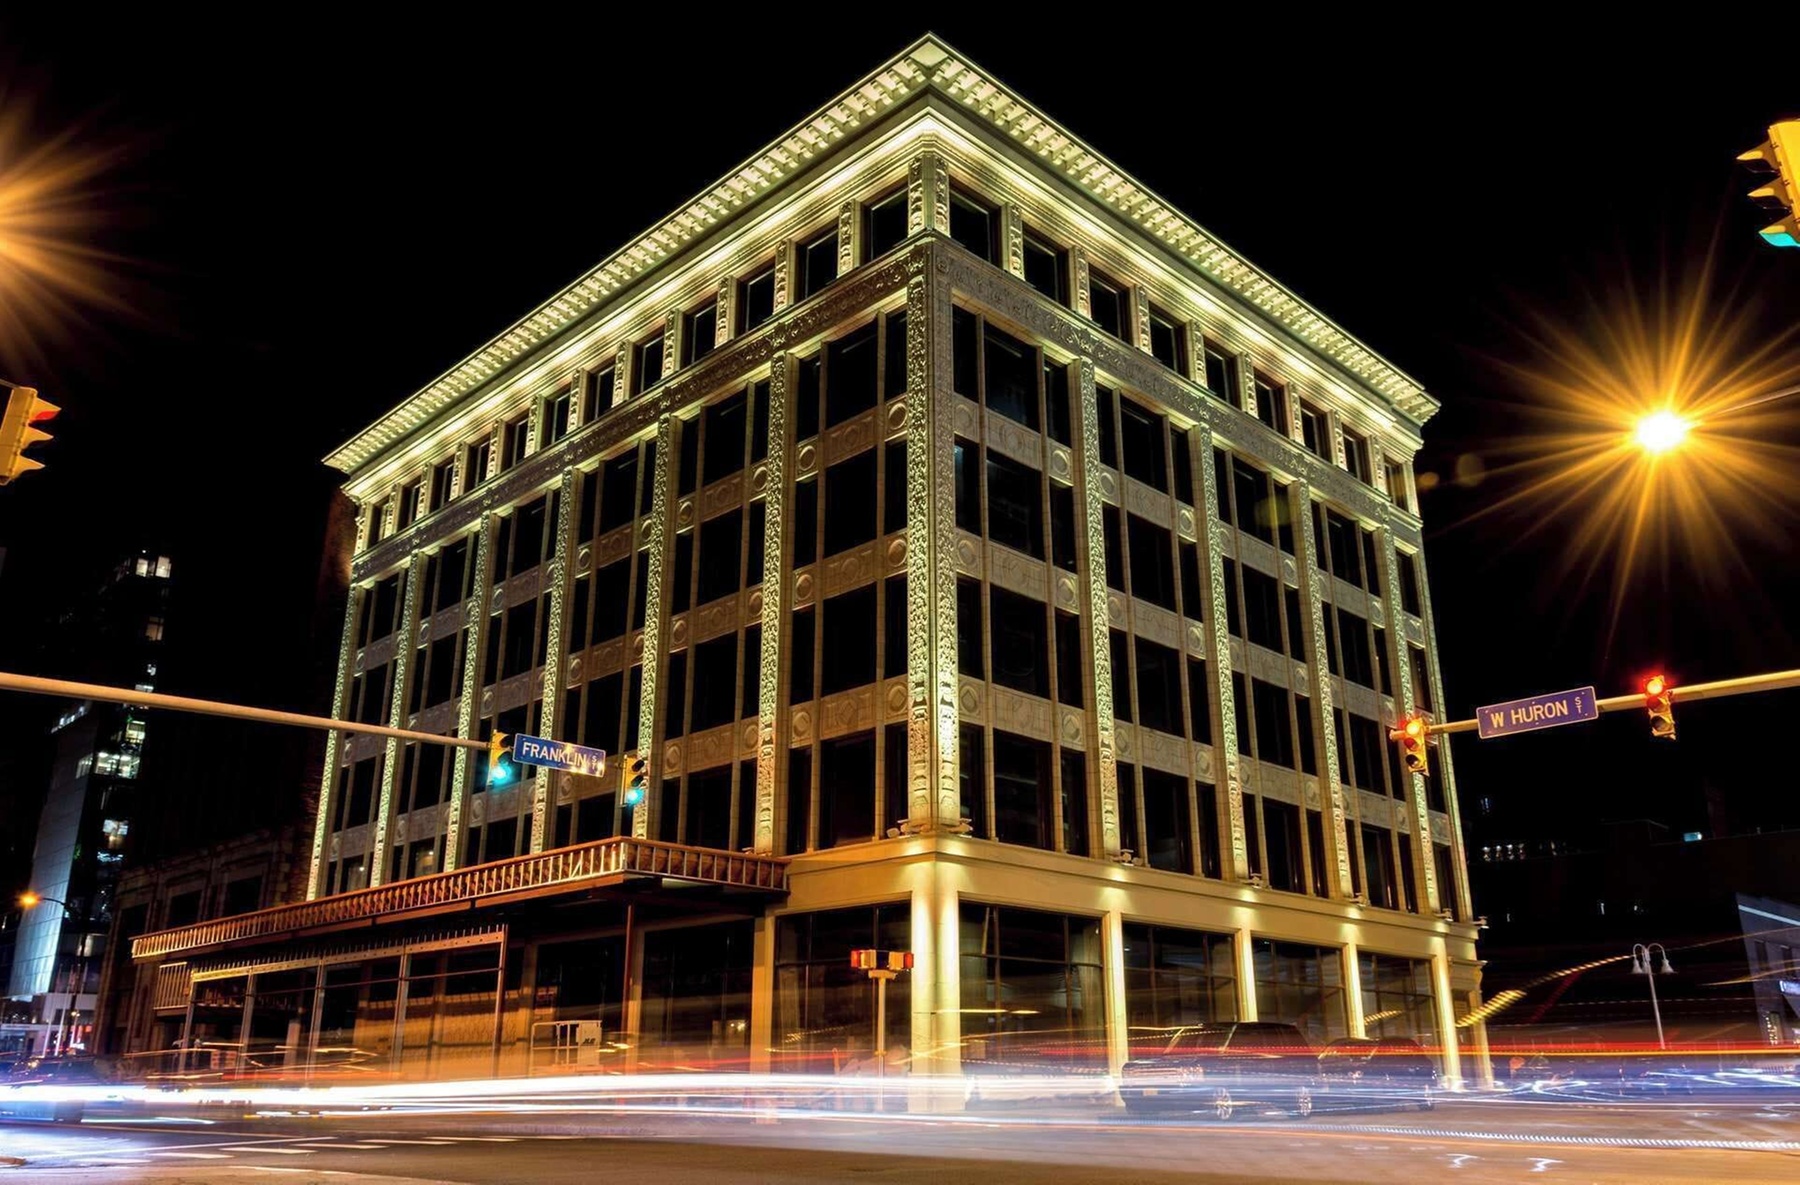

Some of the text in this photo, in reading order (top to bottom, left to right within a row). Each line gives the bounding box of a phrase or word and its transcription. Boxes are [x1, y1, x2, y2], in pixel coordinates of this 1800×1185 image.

[1490, 696, 1582, 728] W HURON ST
[522, 742, 587, 767] FRANKLIN
